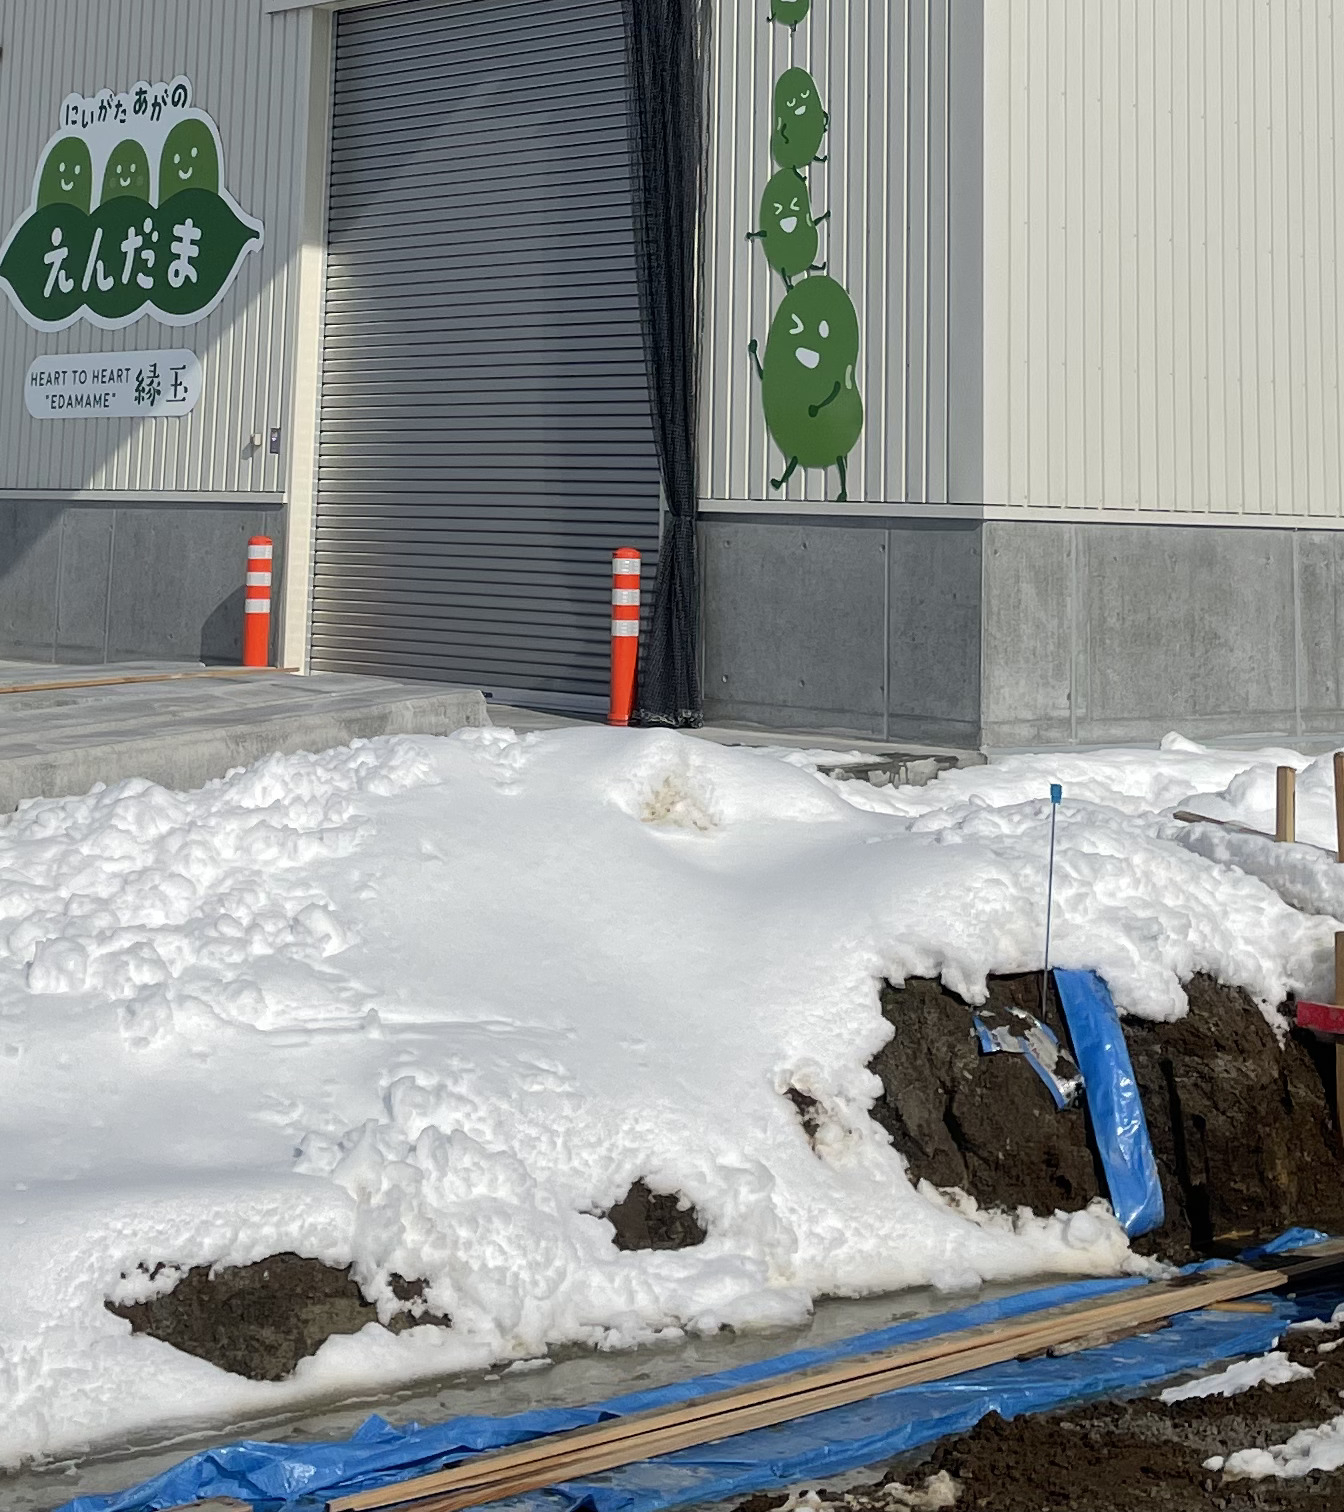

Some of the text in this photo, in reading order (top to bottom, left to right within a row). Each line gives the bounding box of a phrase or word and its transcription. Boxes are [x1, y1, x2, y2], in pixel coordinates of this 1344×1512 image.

[43, 217, 202, 298] えんだま
[30, 368, 131, 387] HEART TO HEART
